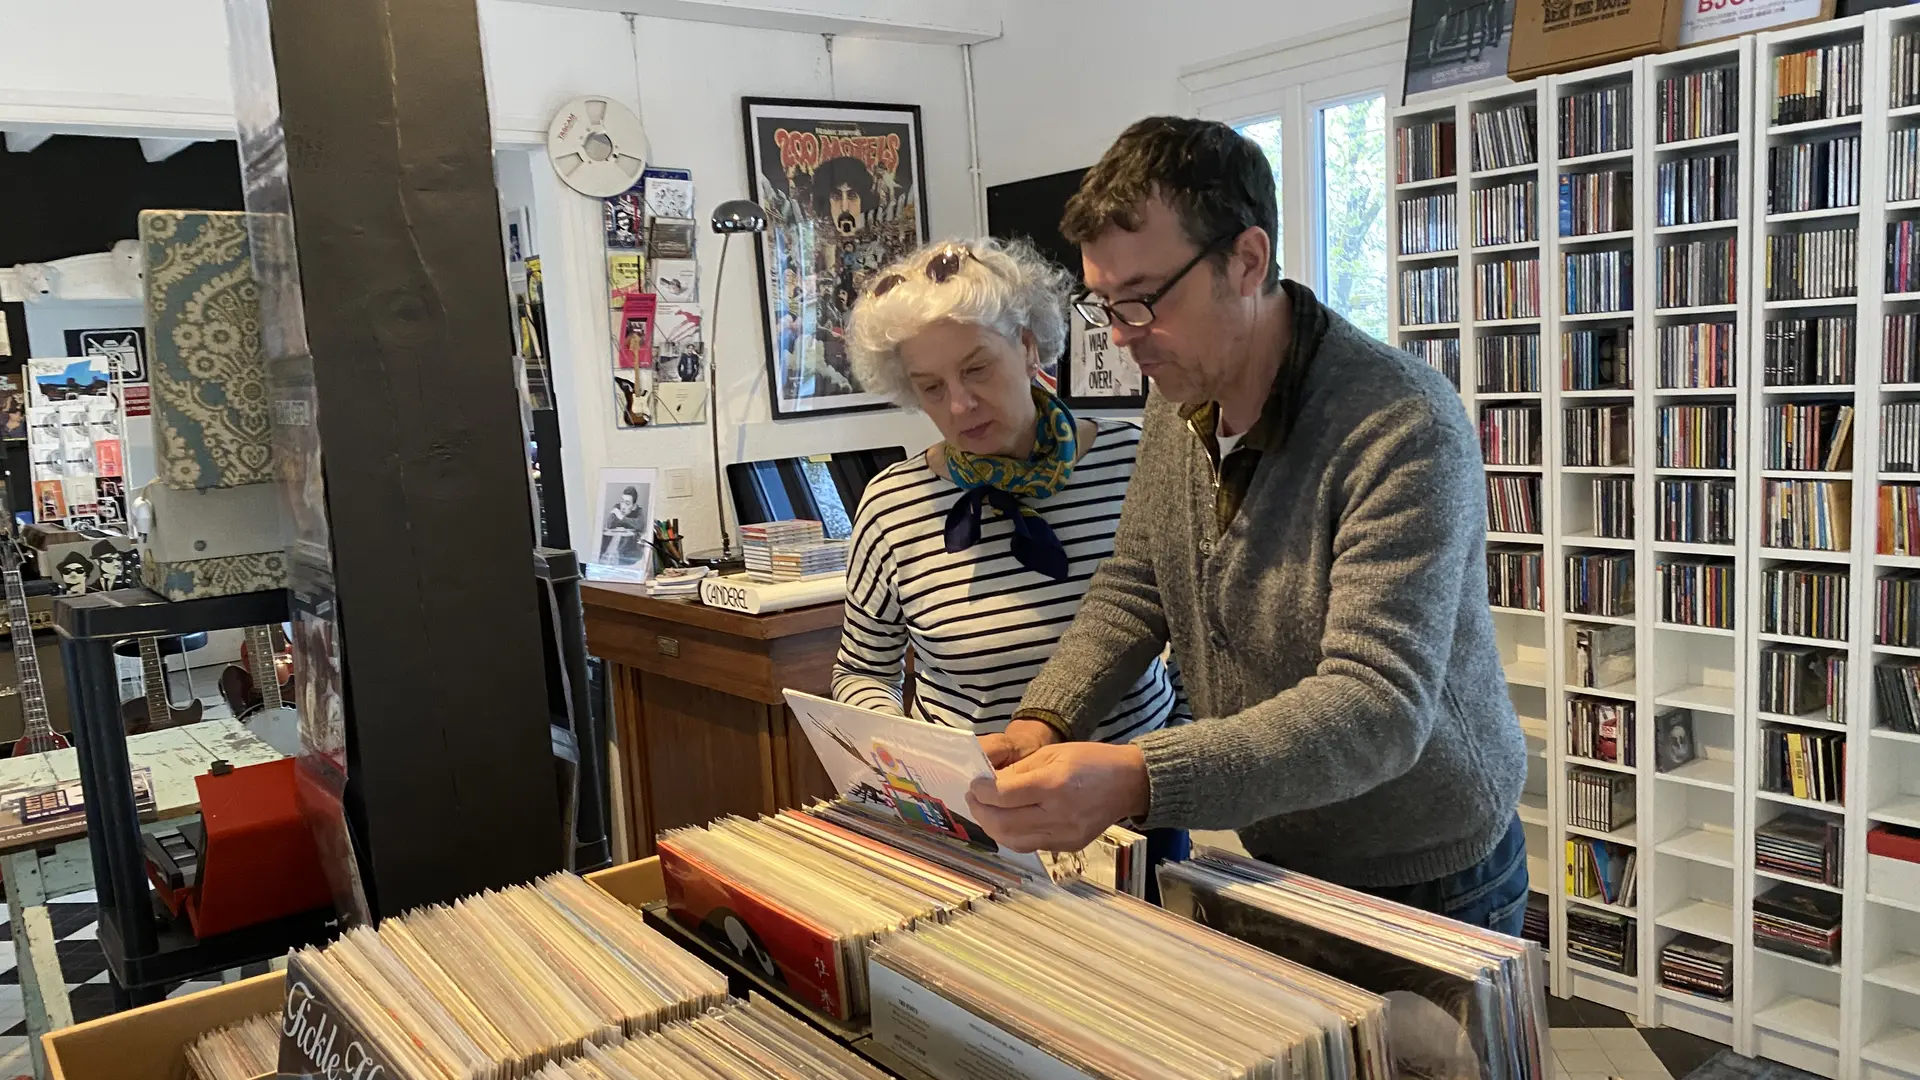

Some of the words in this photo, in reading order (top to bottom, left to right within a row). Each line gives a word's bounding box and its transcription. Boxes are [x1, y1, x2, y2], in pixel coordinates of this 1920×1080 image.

[557, 112, 577, 141] TASCAM
[774, 128, 819, 168] 200
[819, 133, 900, 174] MOTELS
[1088, 332, 1108, 352] WAR
[1094, 351, 1104, 370] IS
[1088, 370, 1113, 389] OVER!
[7, 831, 33, 840] FLOYD
